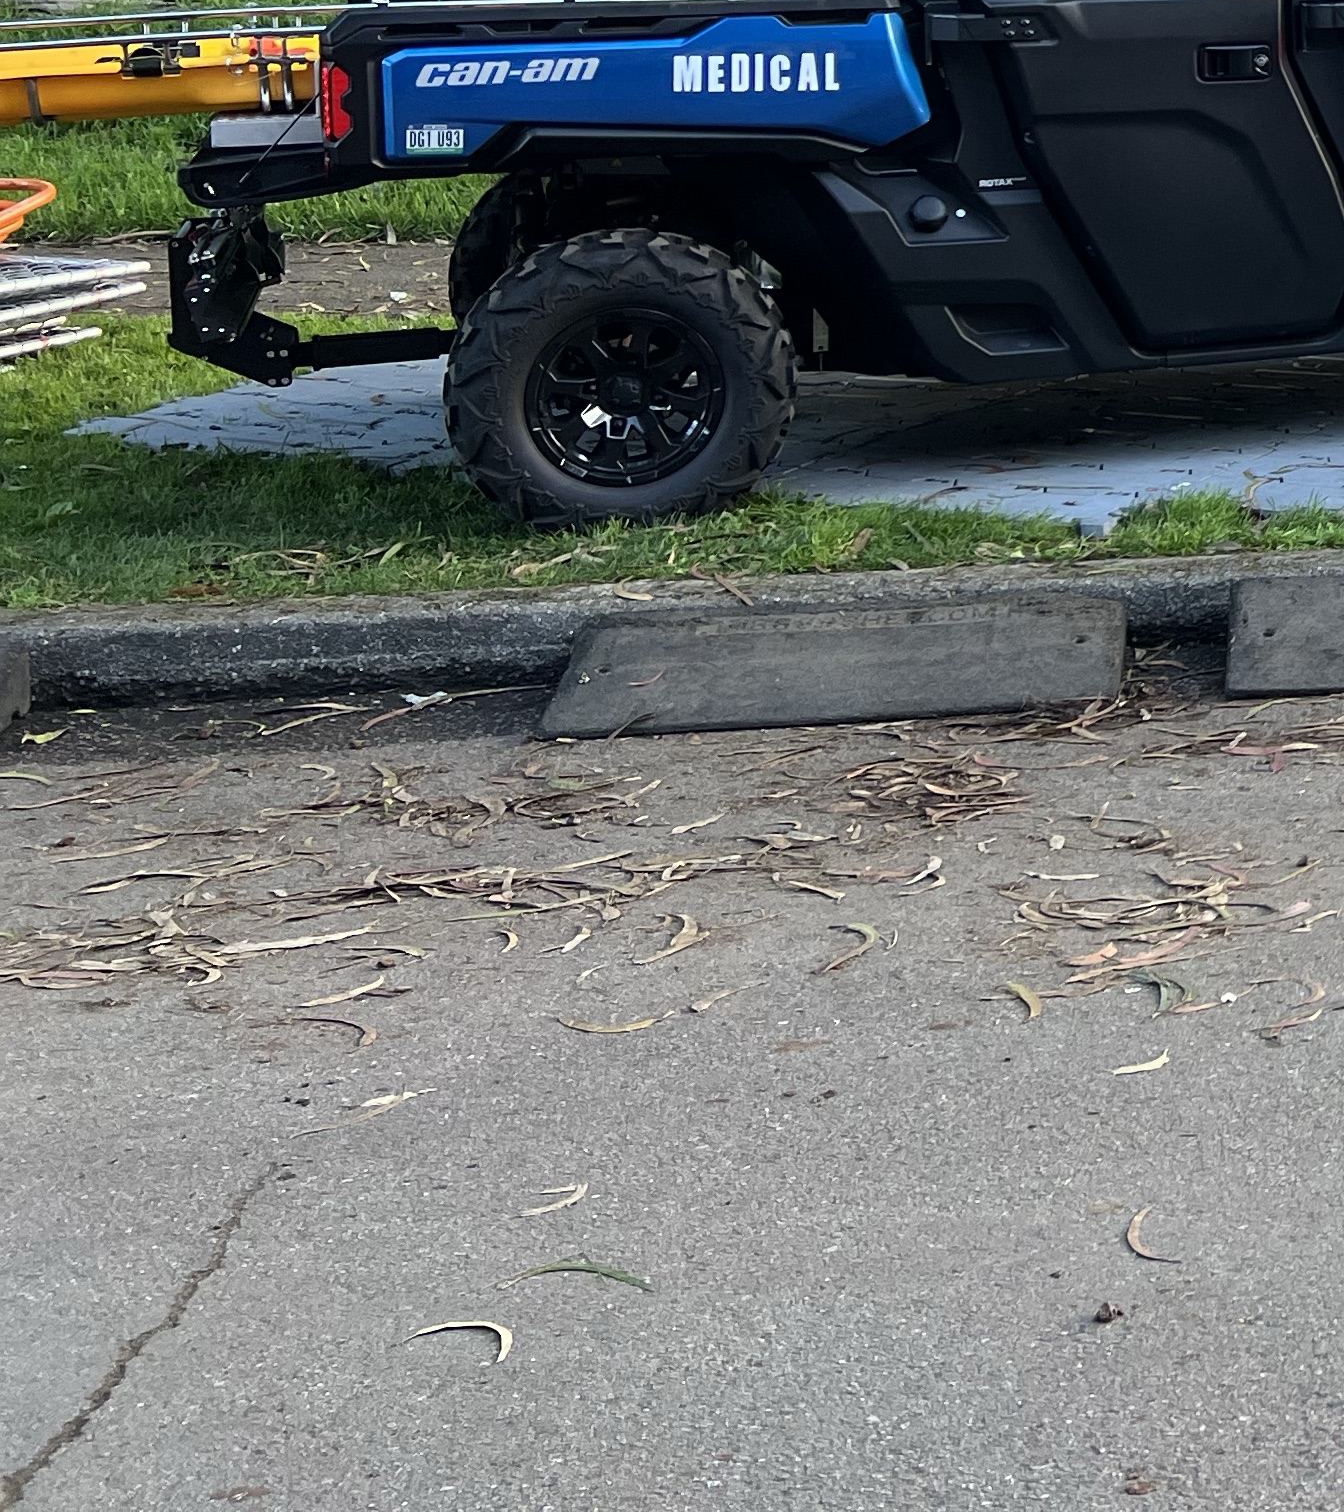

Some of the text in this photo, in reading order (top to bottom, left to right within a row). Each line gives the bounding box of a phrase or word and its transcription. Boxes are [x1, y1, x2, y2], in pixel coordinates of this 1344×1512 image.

[415, 57, 600, 88] can-am
[672, 53, 841, 93] MEDICAL
[410, 130, 460, 147] DG1 U93
